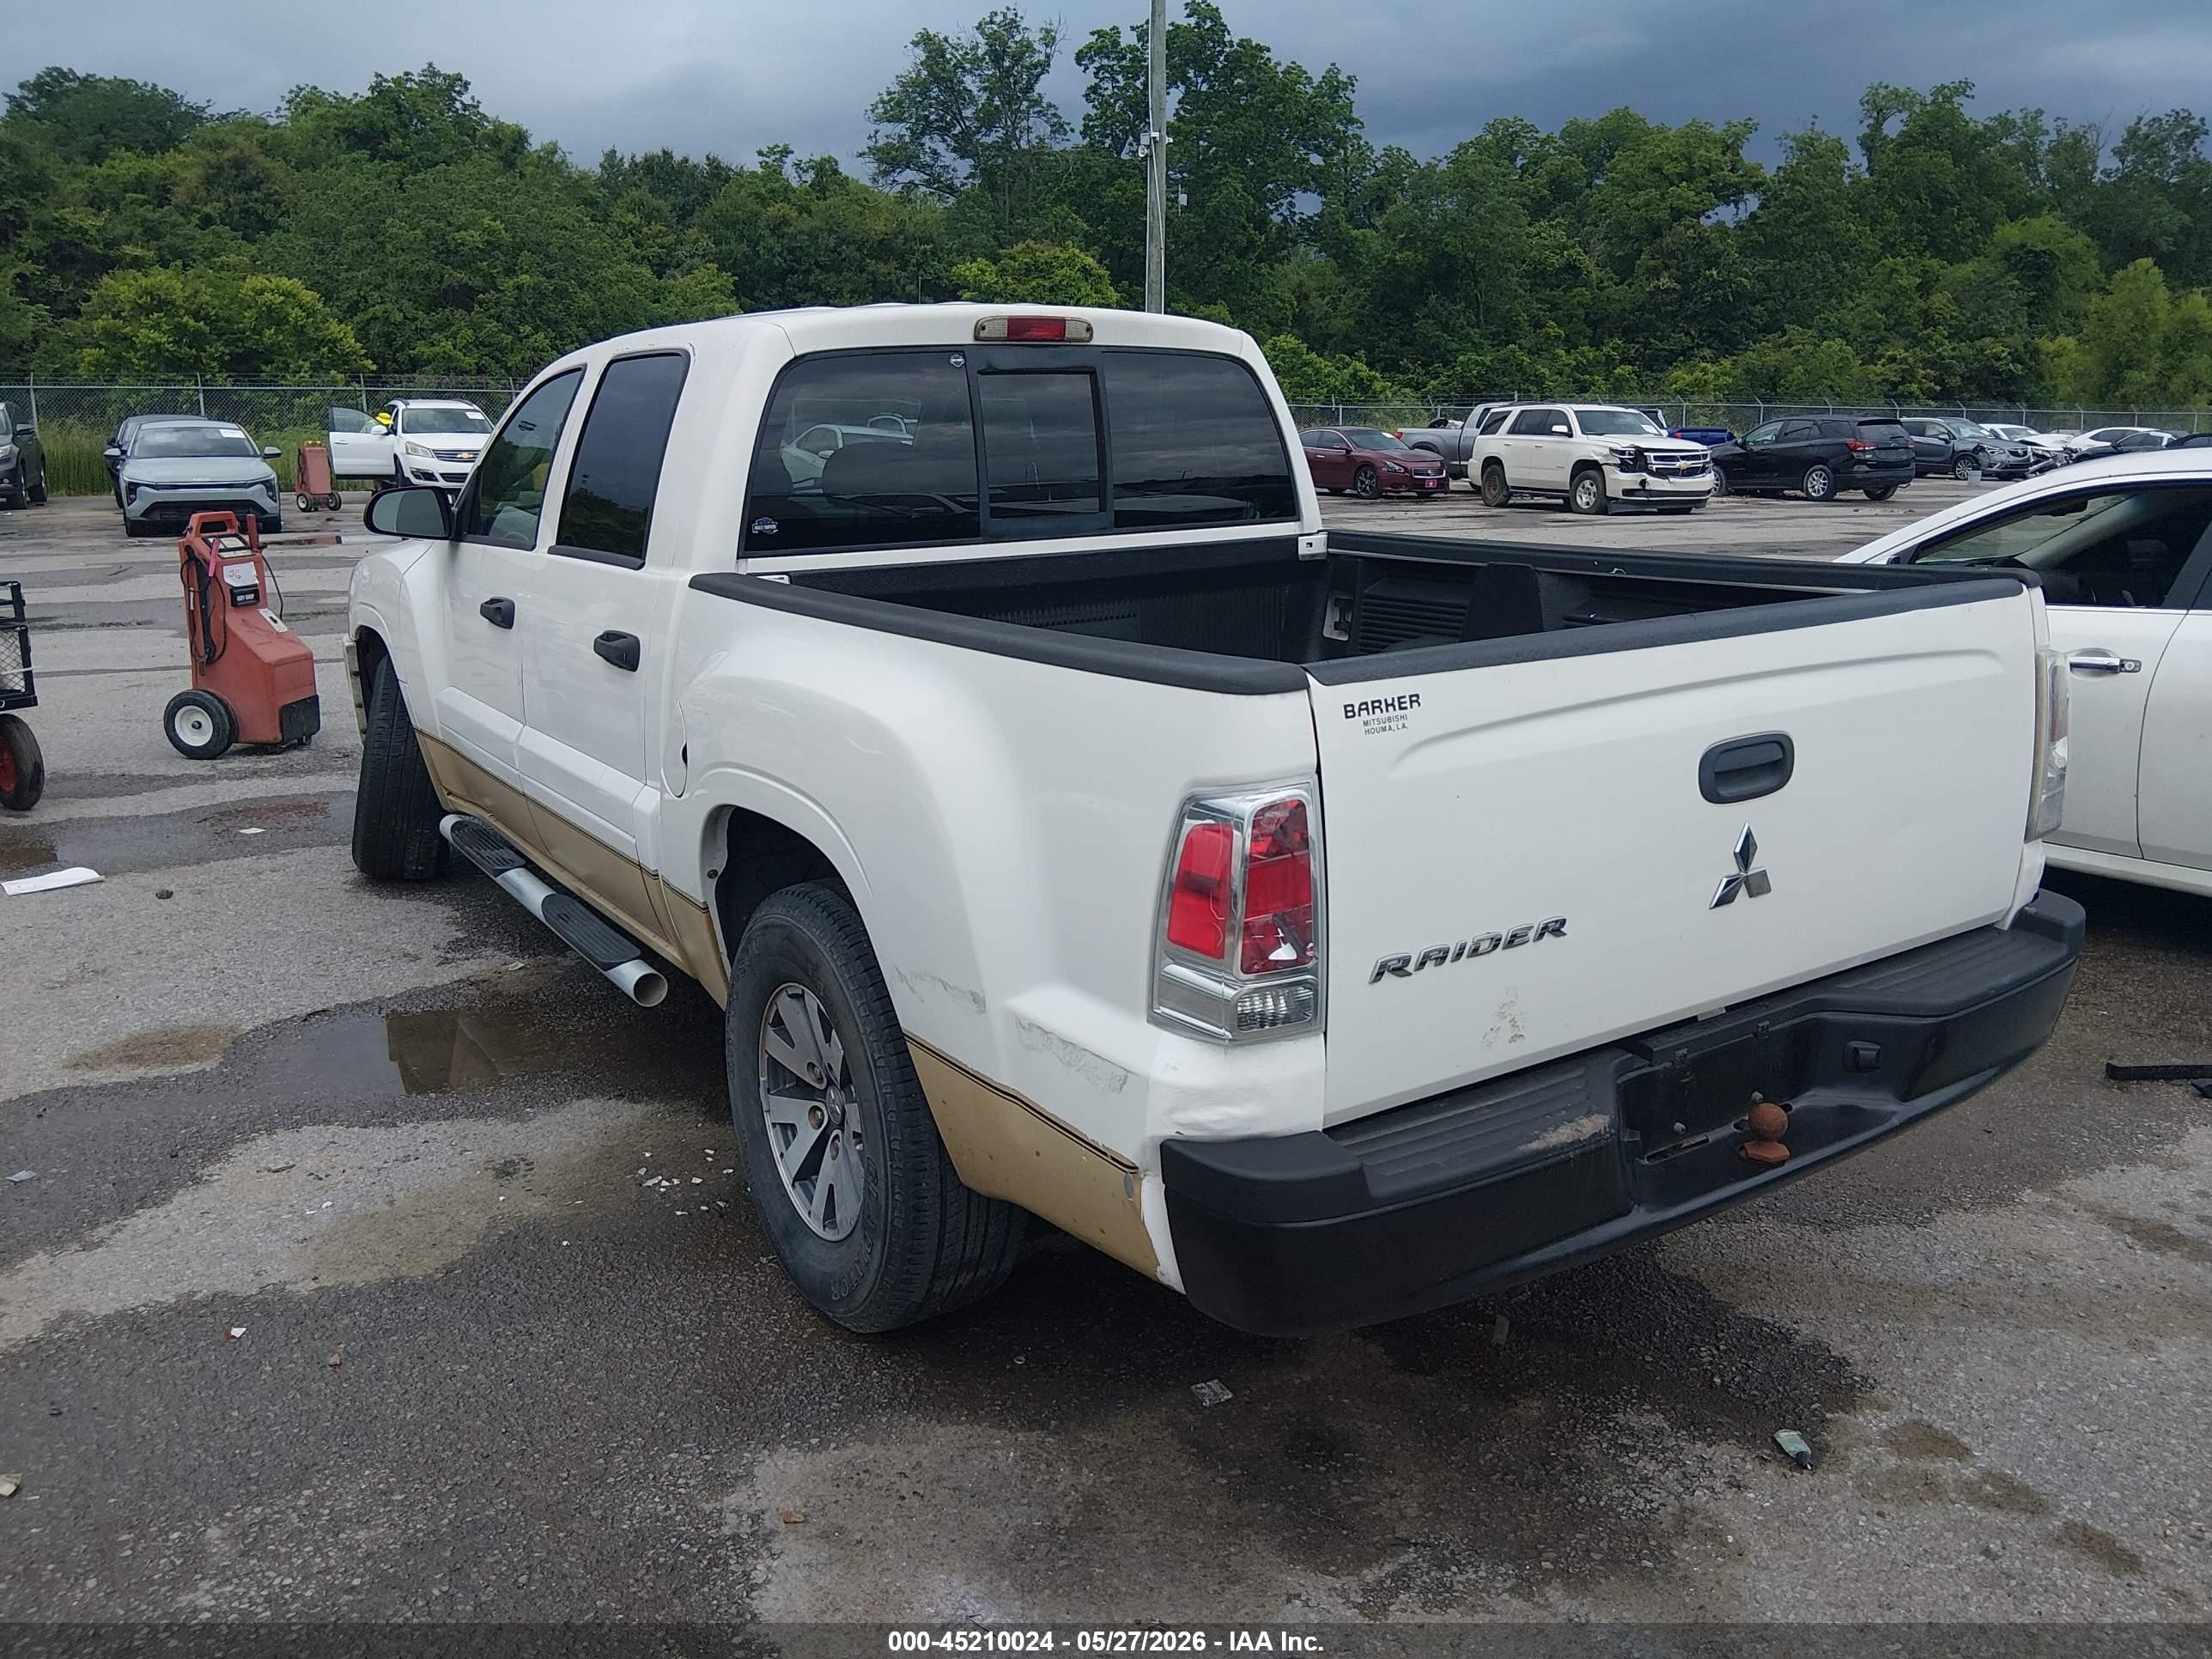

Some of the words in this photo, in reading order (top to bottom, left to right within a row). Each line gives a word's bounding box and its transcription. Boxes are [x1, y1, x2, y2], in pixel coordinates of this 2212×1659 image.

[1343, 693, 1421, 720] BARKER
[1363, 714, 1408, 727] MITSUBISHI
[1364, 724, 1395, 736] HOUMA,
[1368, 915, 1568, 985] RAIDER
